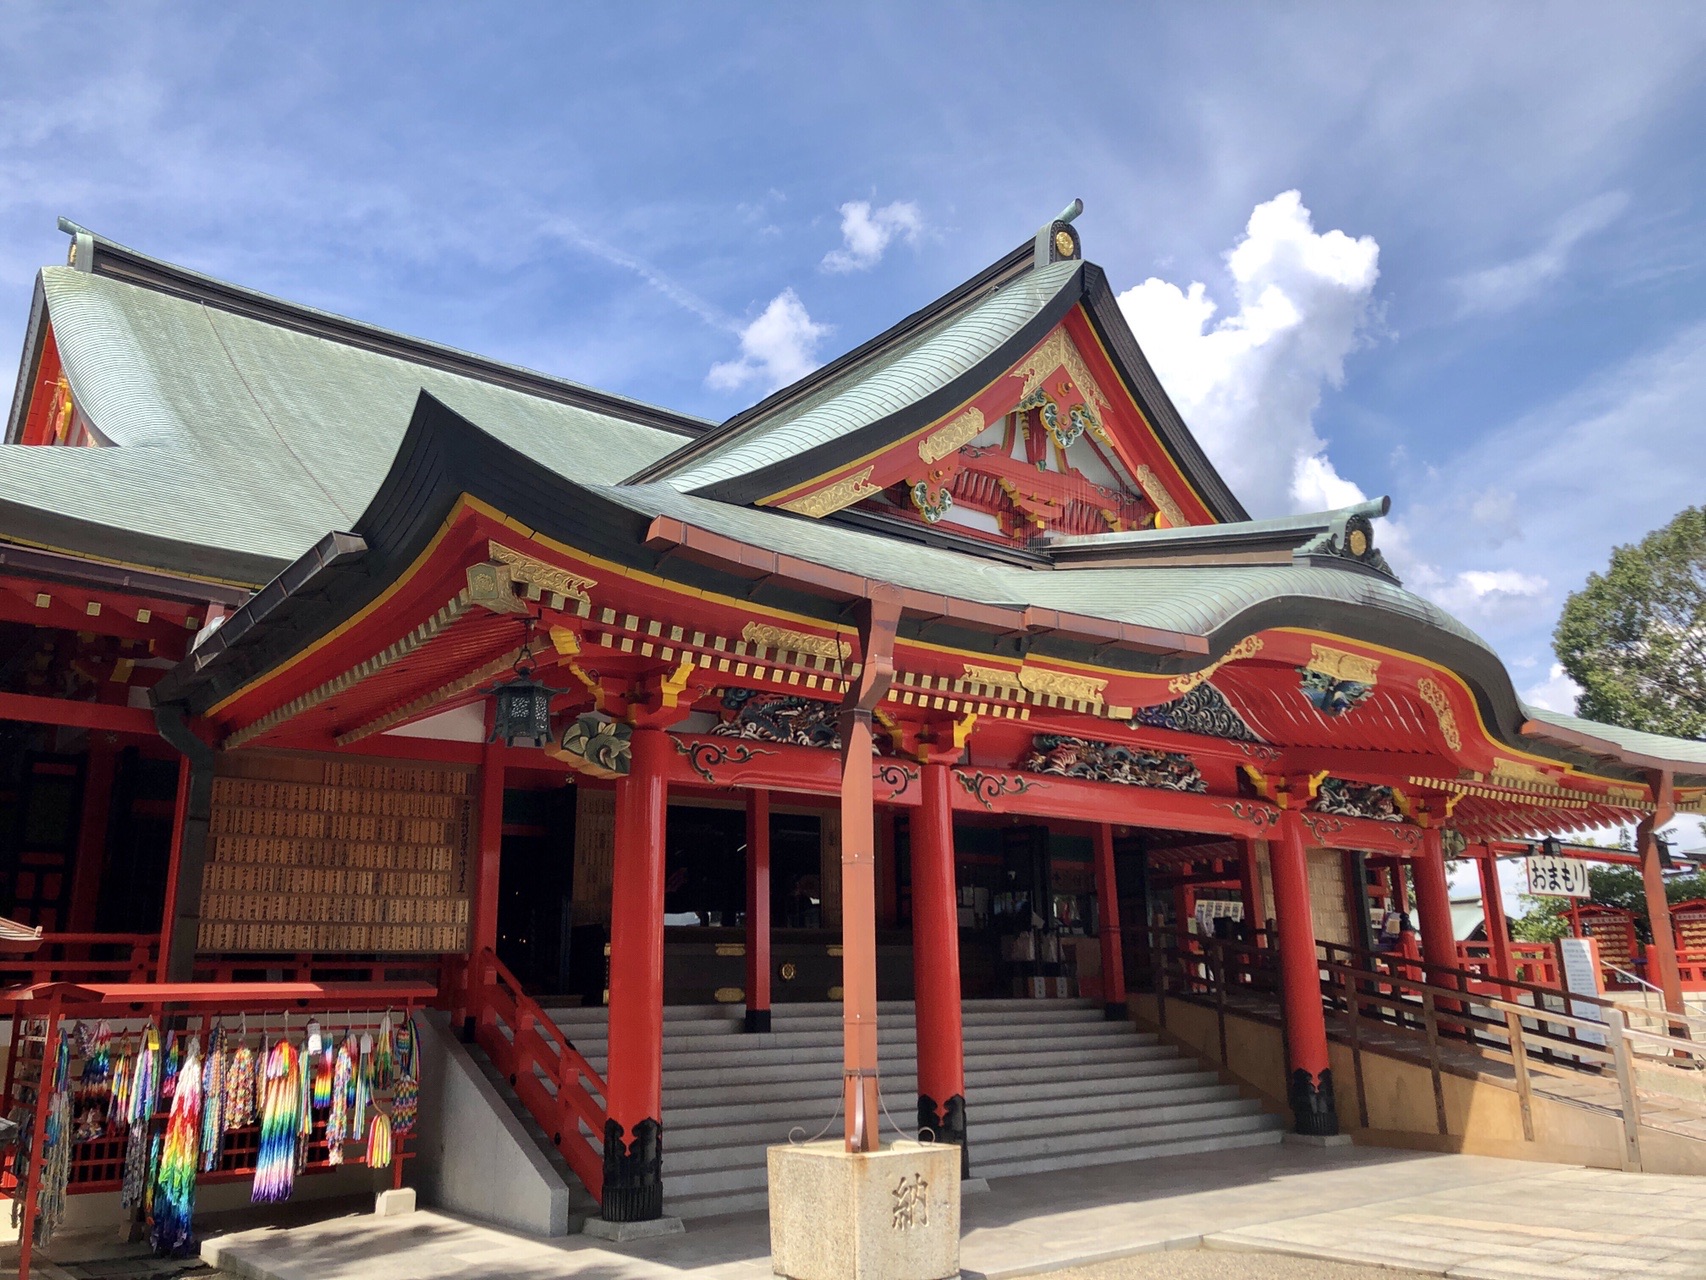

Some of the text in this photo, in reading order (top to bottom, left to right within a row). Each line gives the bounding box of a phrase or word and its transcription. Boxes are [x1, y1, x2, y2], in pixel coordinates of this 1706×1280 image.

[1531, 859, 1585, 893] おまもり
[892, 1172, 929, 1231] 納
